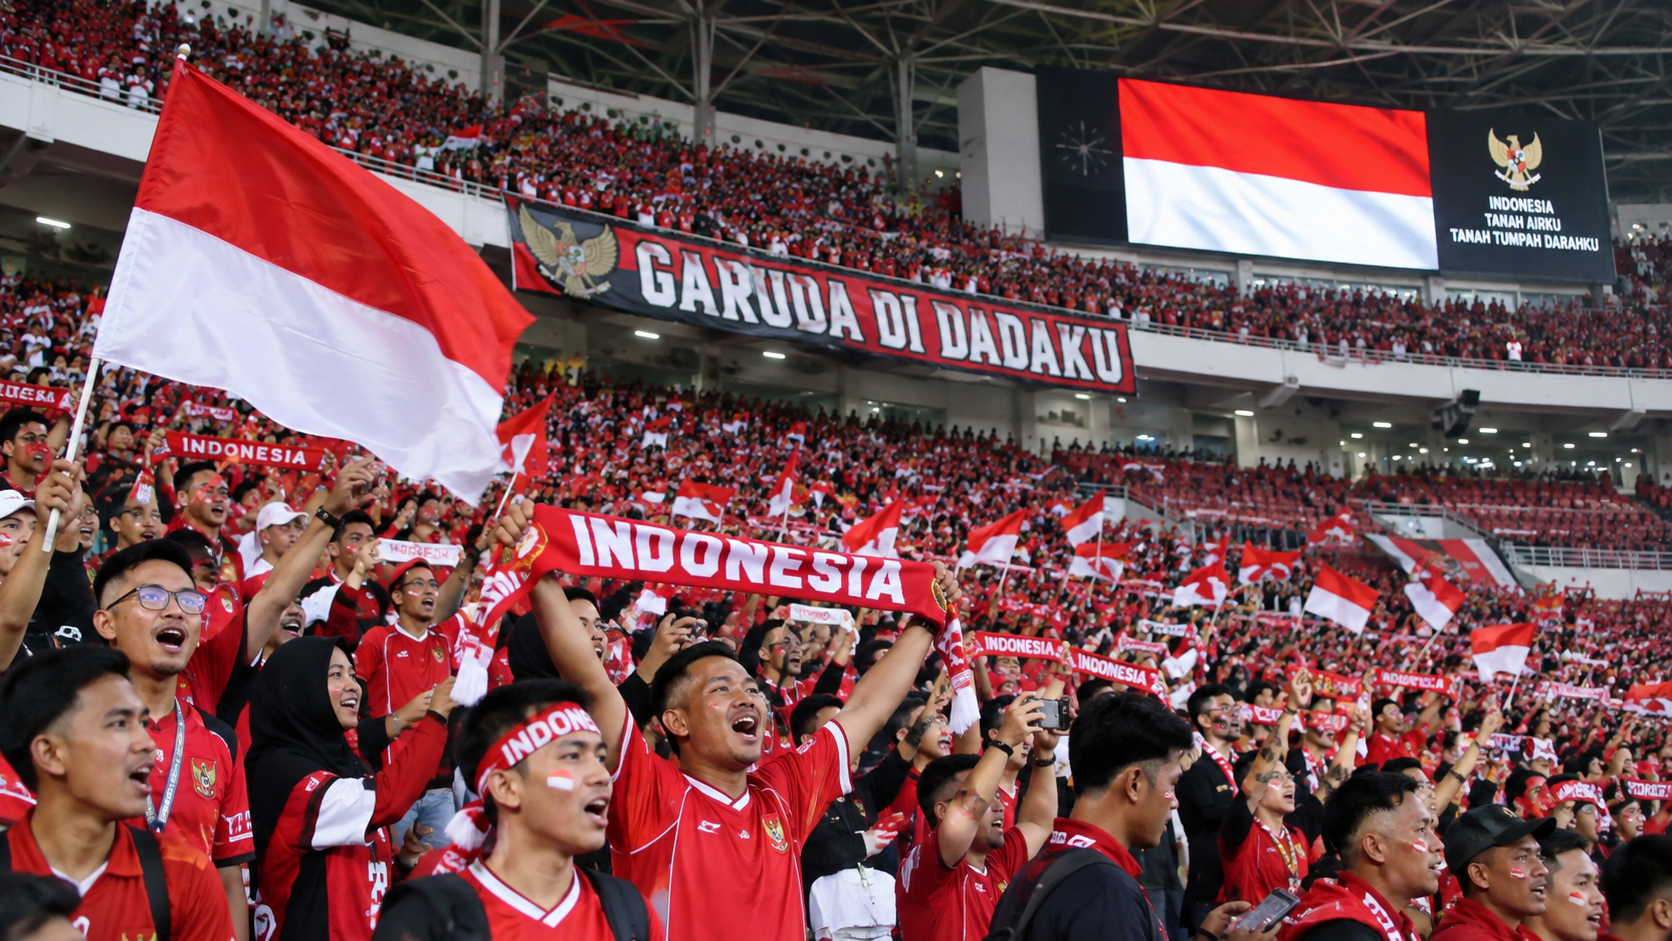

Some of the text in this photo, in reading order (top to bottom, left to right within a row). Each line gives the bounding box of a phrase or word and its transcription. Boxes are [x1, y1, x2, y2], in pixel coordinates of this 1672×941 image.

[1489, 196, 1554, 213] INDONESIA
[1484, 213, 1561, 231] TANAH AIRKU
[1450, 228, 1599, 251] TANAH TUMPAH DARAHKU
[635, 240, 1123, 384] GARUDA DI DADAKU
[182, 437, 306, 465] INDONESIA
[568, 514, 906, 605] INDONESIA
[984, 636, 1055, 656] INDONESIA
[1078, 653, 1147, 686] INDONESIA
